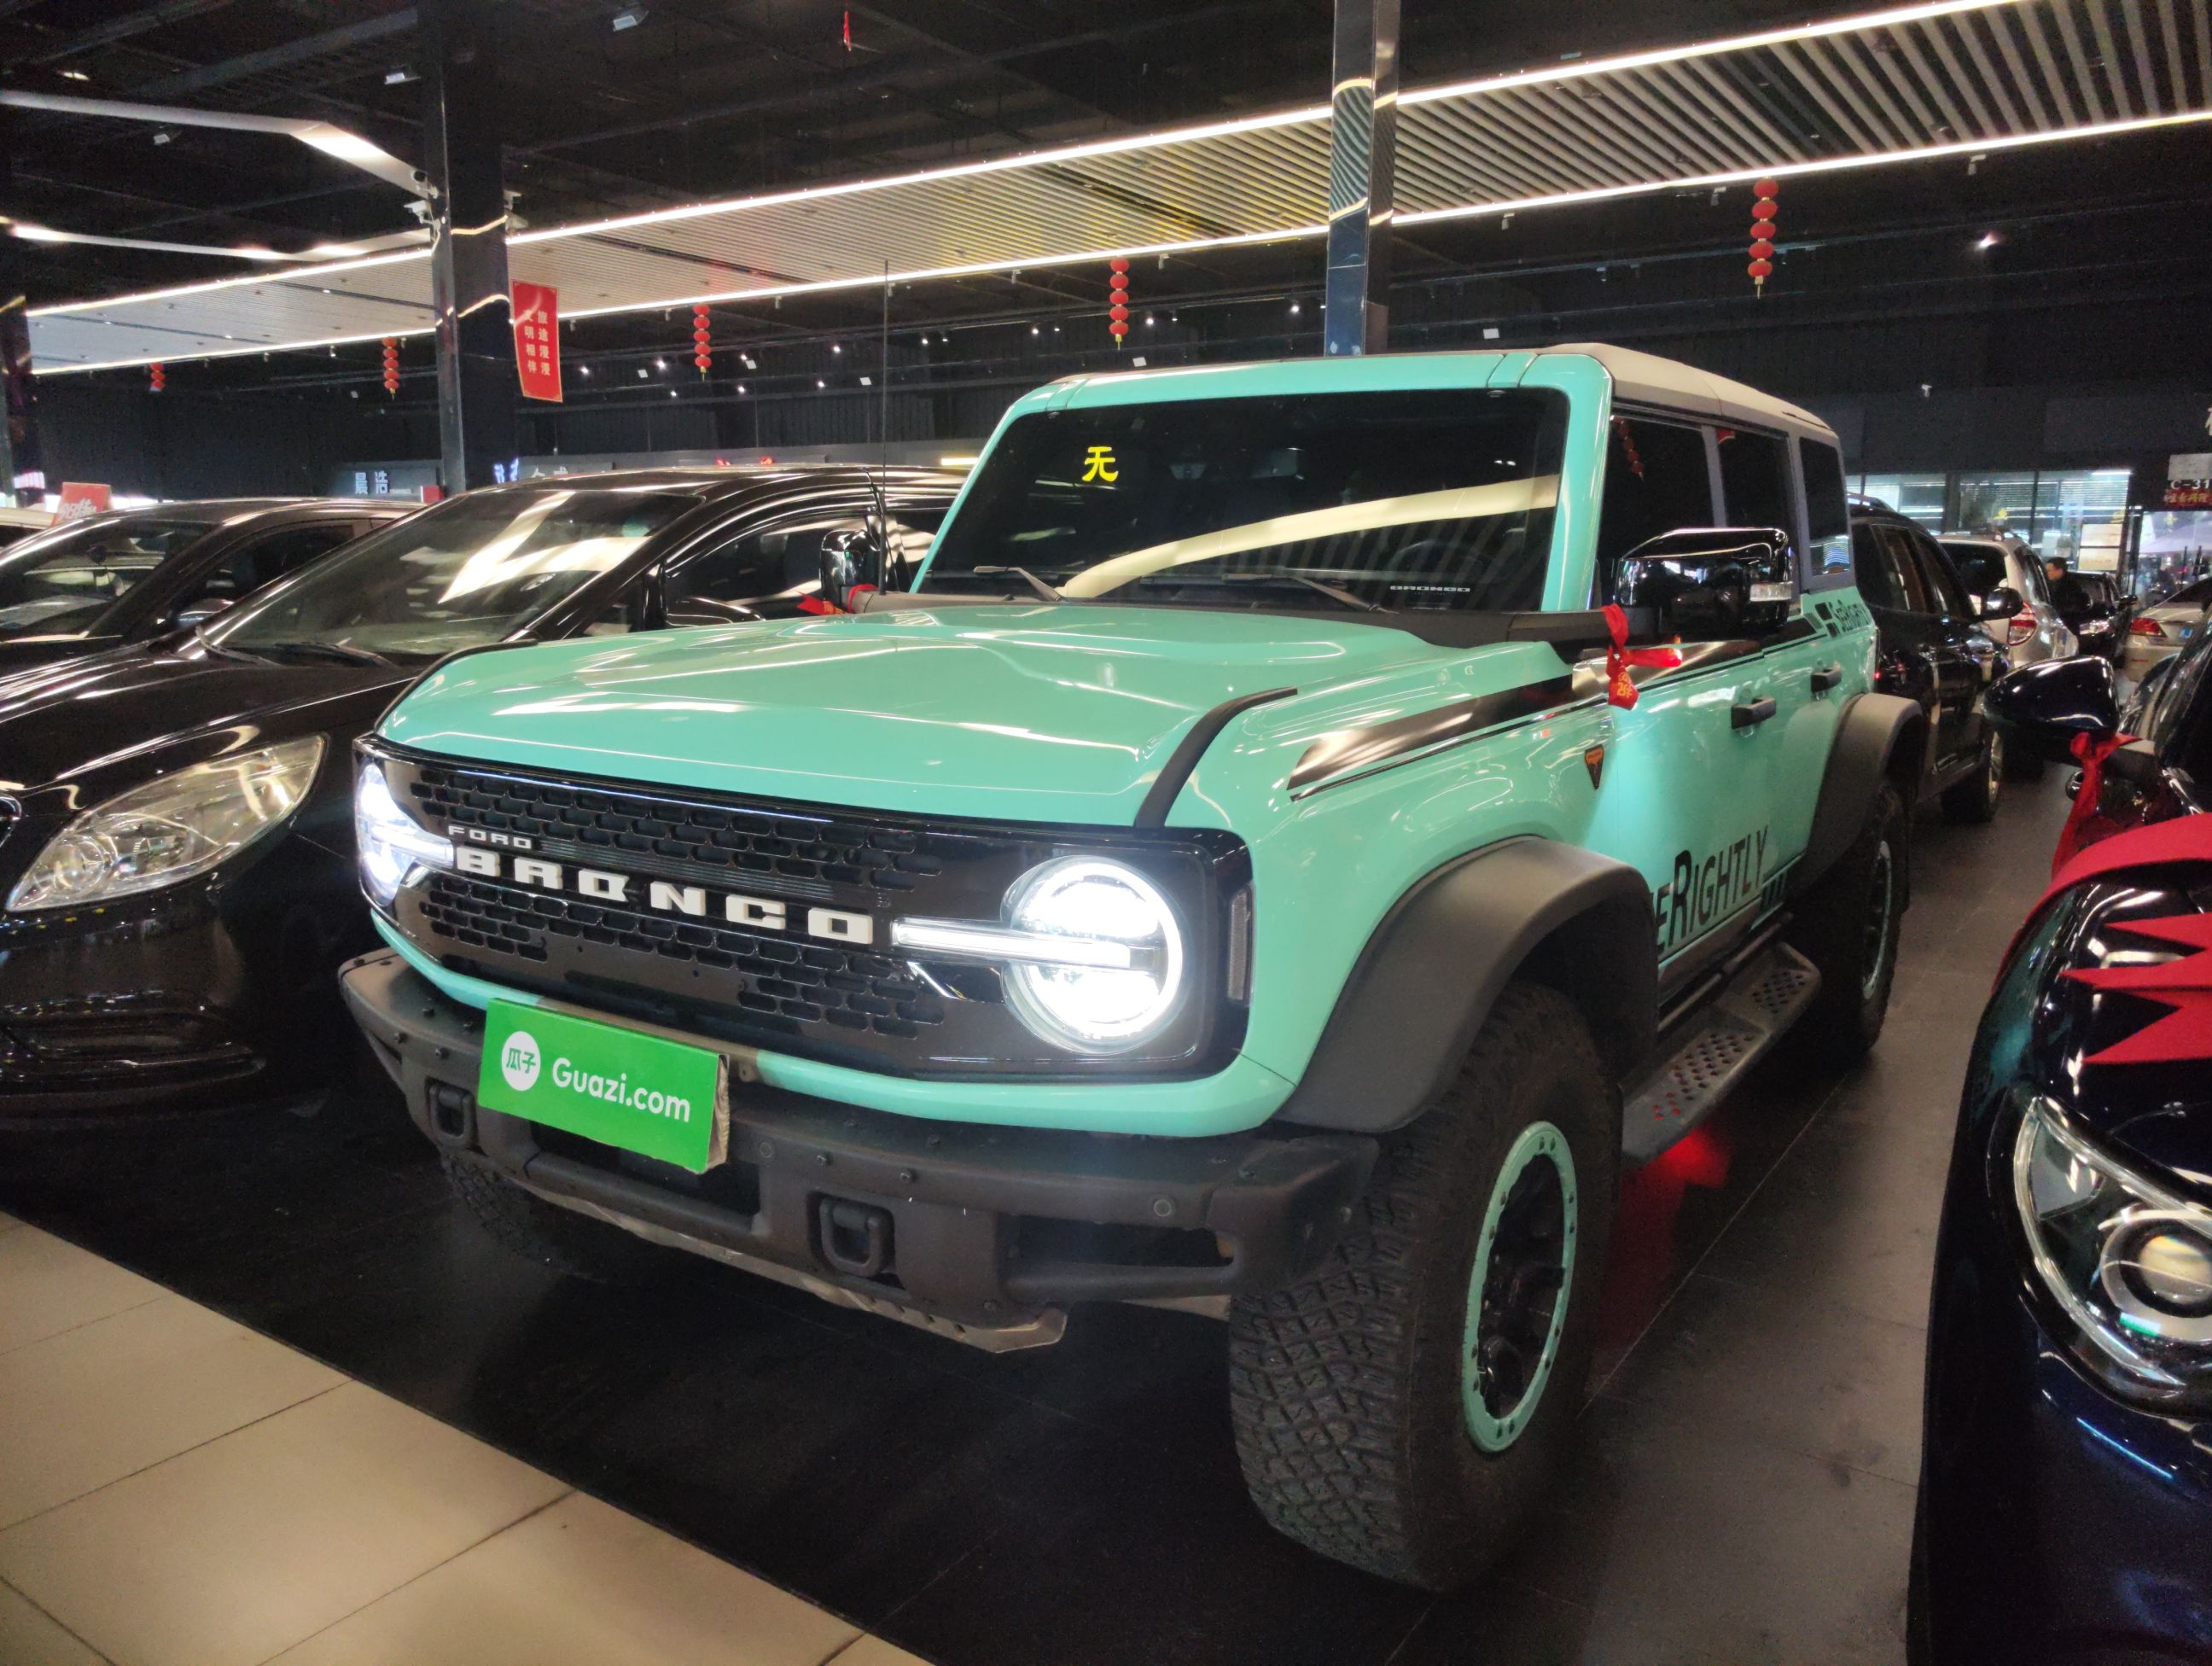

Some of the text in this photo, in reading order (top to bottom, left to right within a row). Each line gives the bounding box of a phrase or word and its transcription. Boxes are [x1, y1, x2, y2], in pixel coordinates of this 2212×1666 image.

[1082, 446, 1119, 481] 无
[448, 824, 533, 850] FORD
[457, 846, 874, 945] BRONCO
[506, 1047, 537, 1075] 瓜子
[552, 1057, 690, 1123] Guazi.com
